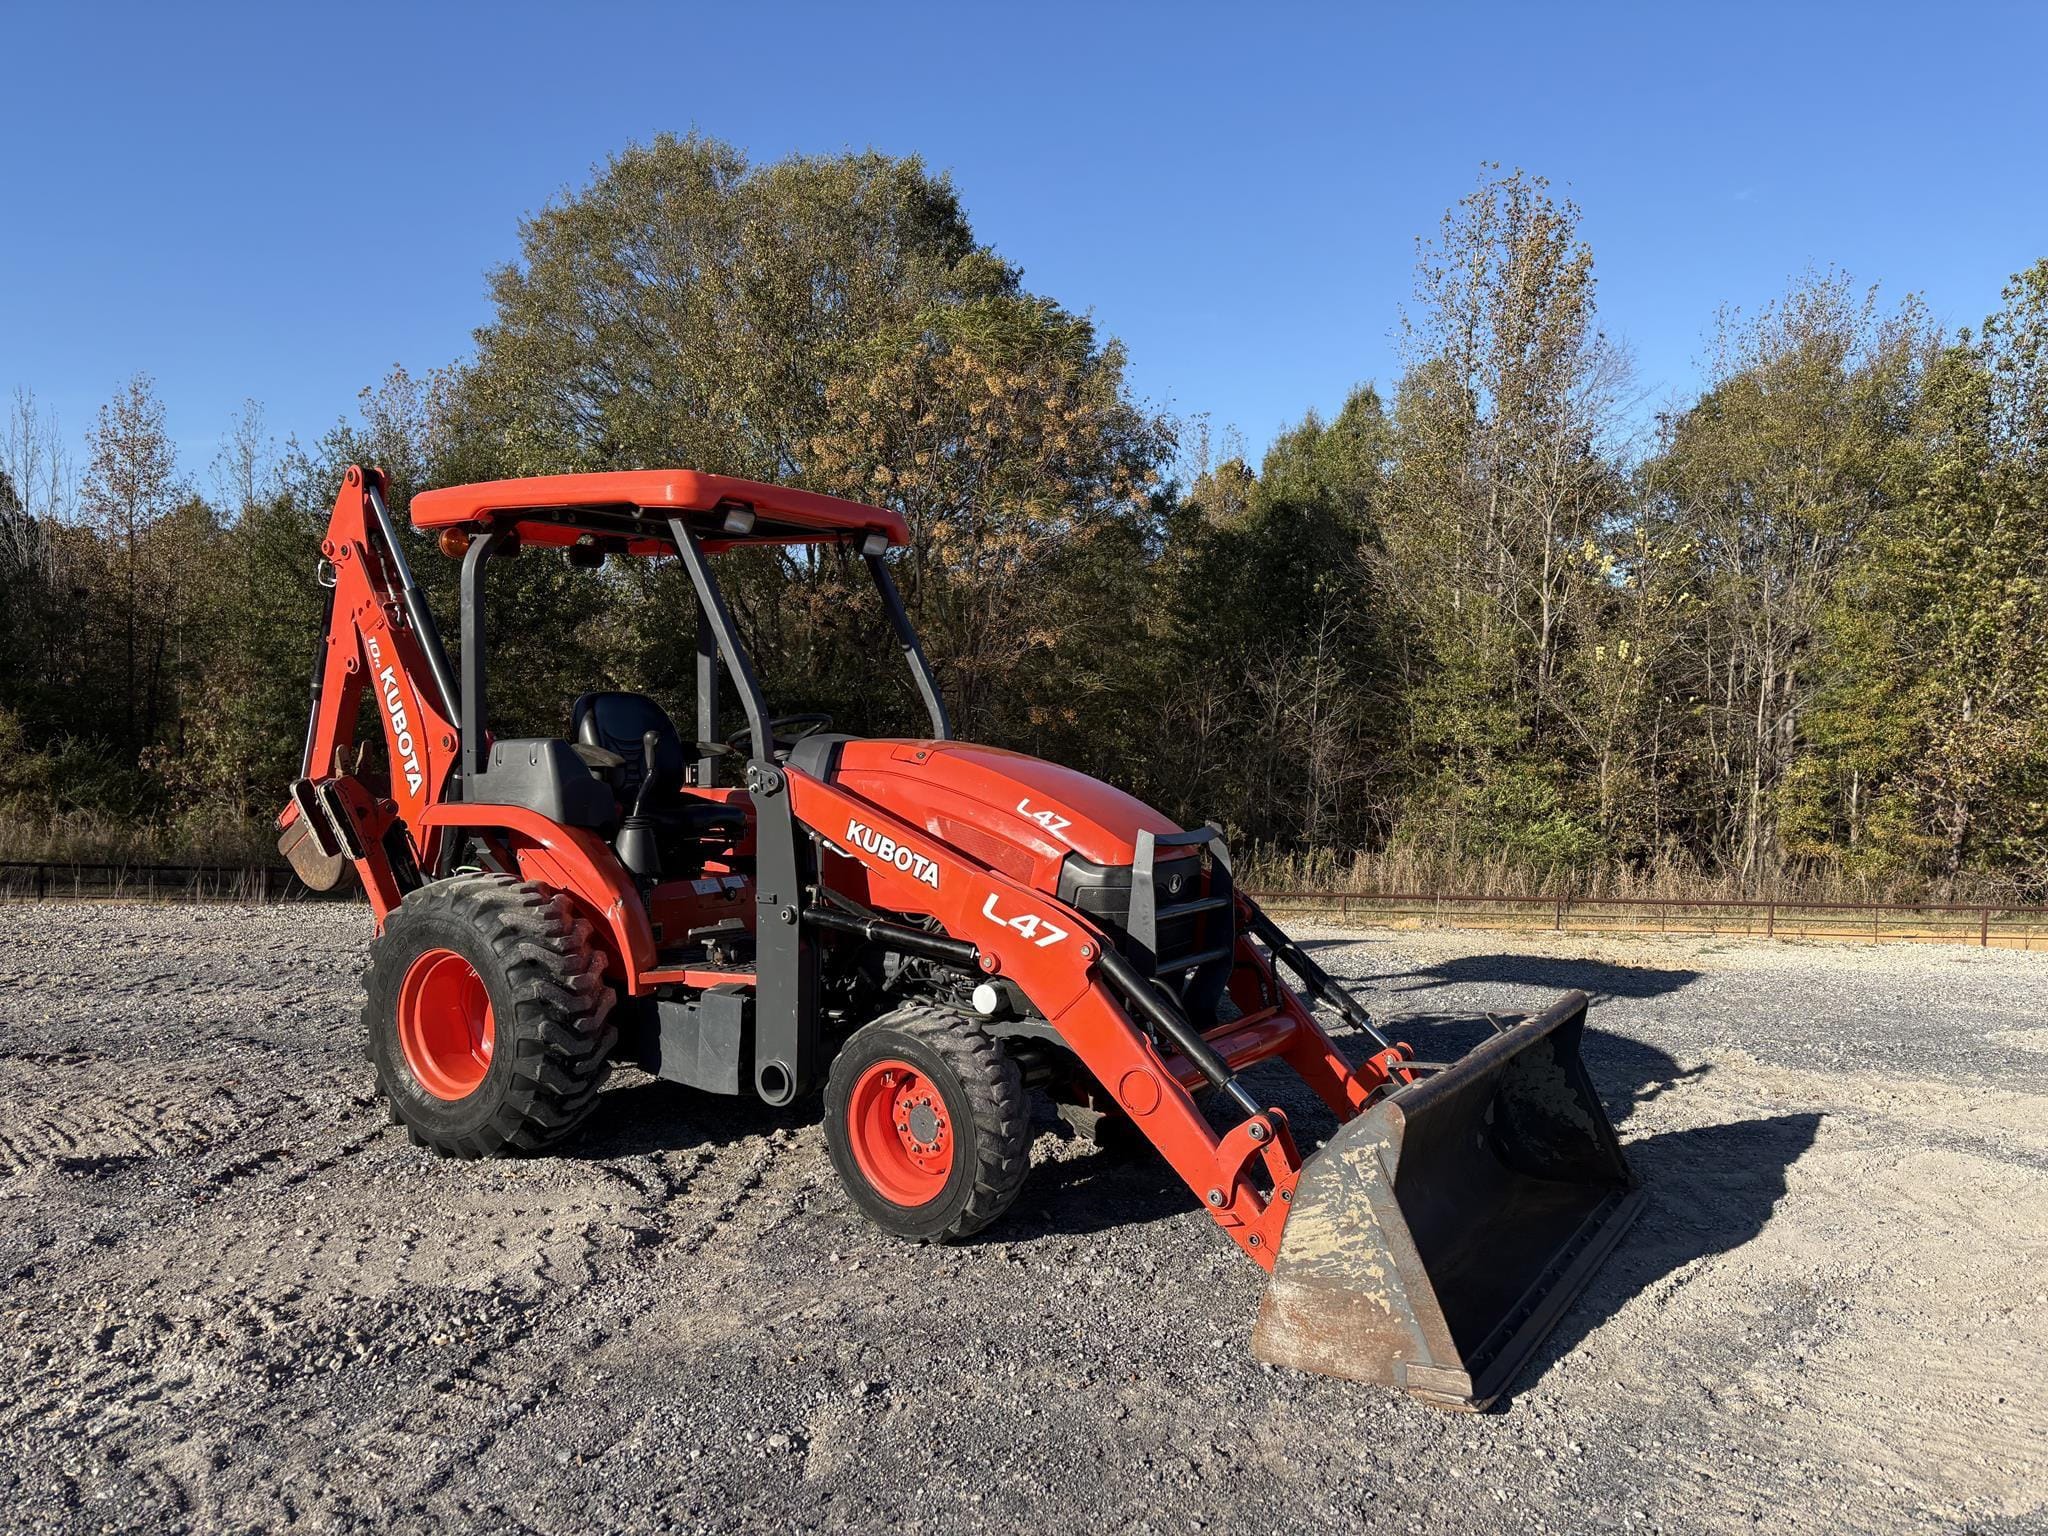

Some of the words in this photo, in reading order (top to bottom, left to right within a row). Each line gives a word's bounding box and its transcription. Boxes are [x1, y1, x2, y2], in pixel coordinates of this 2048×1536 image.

[379, 664, 423, 797] KUBOTA
[1016, 798, 1072, 841] L47
[845, 819, 940, 889] KUBOTA
[981, 892, 1069, 948] L47
